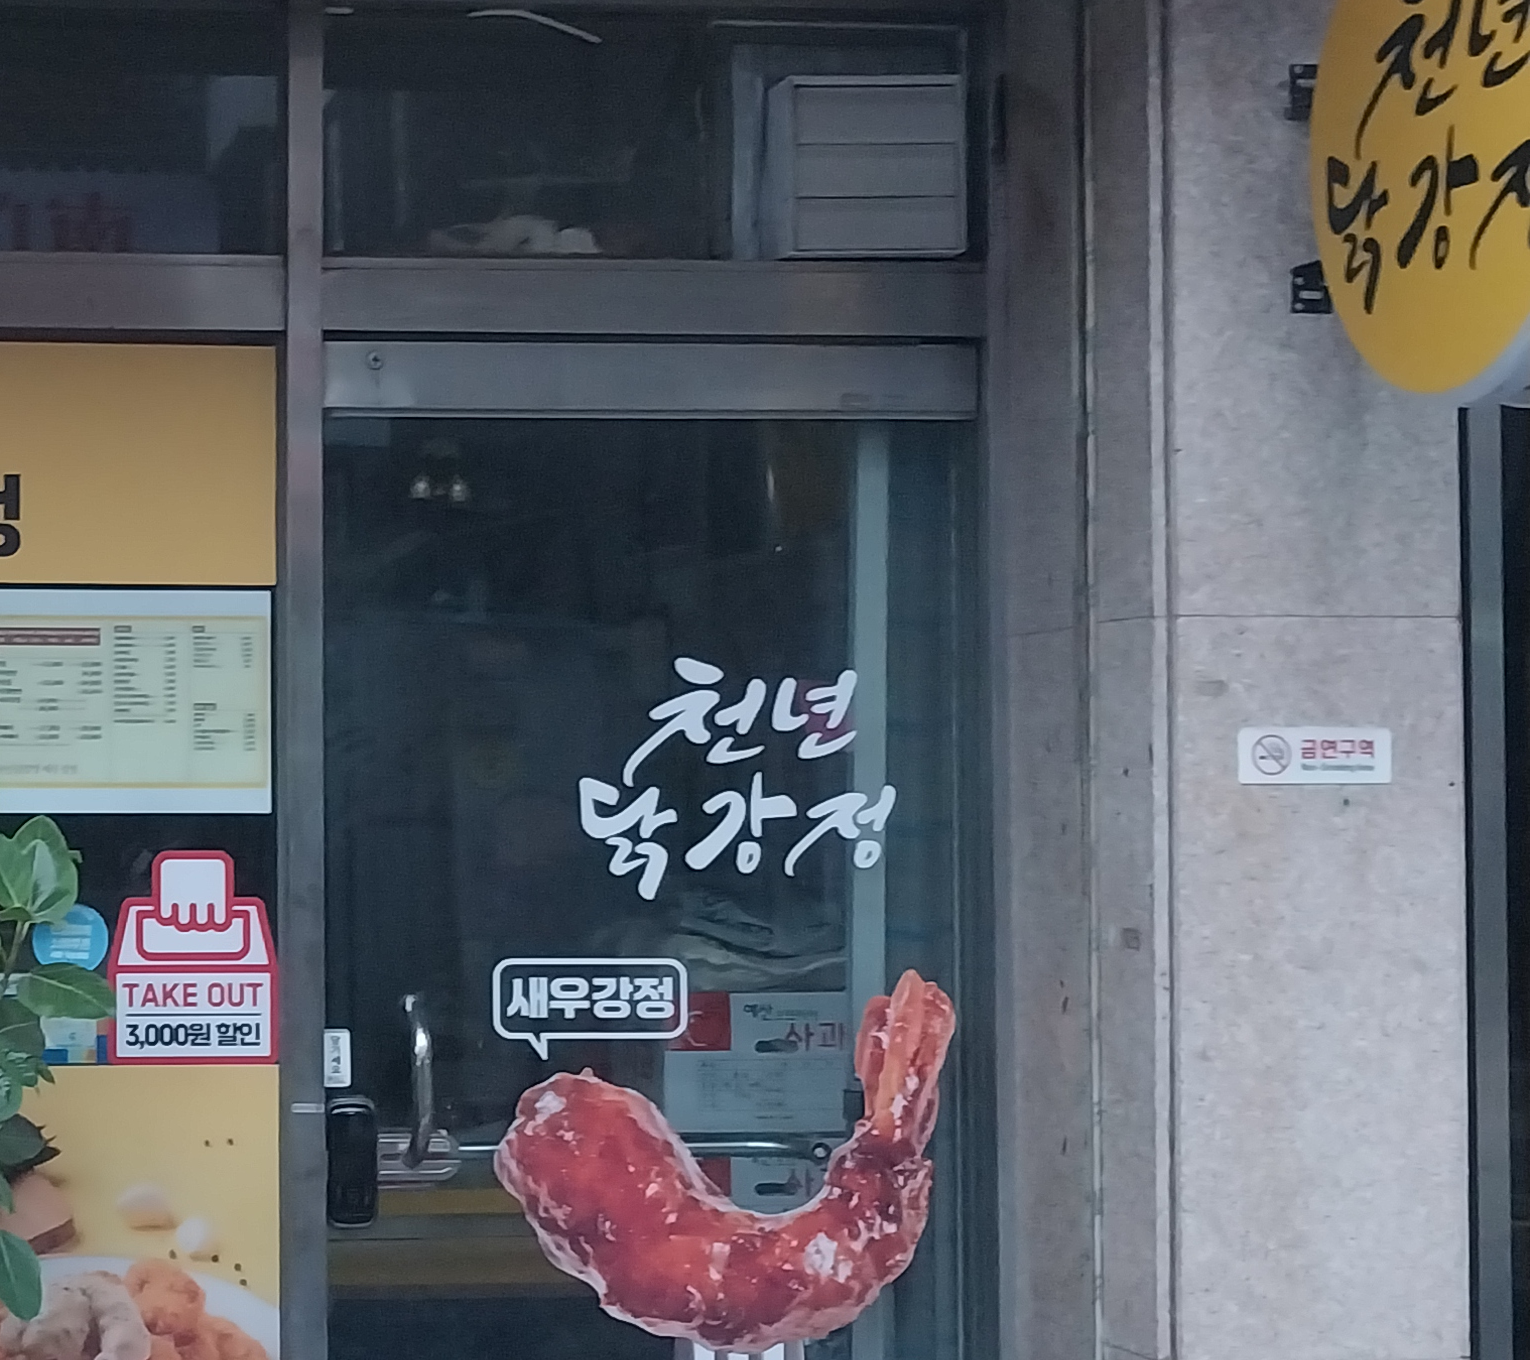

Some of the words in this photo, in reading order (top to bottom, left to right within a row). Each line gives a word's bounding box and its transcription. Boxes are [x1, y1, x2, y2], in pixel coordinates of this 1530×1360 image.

[623, 656, 858, 787] 천년
[1301, 739, 1375, 760] 금연구역
[579, 771, 897, 901] 닭강정
[122, 982, 198, 1008] TAKE
[208, 981, 264, 1008] OUT
[506, 976, 676, 1020] 새우강정
[125, 1022, 212, 1050] 3,000원
[215, 1022, 261, 1047] 할인
